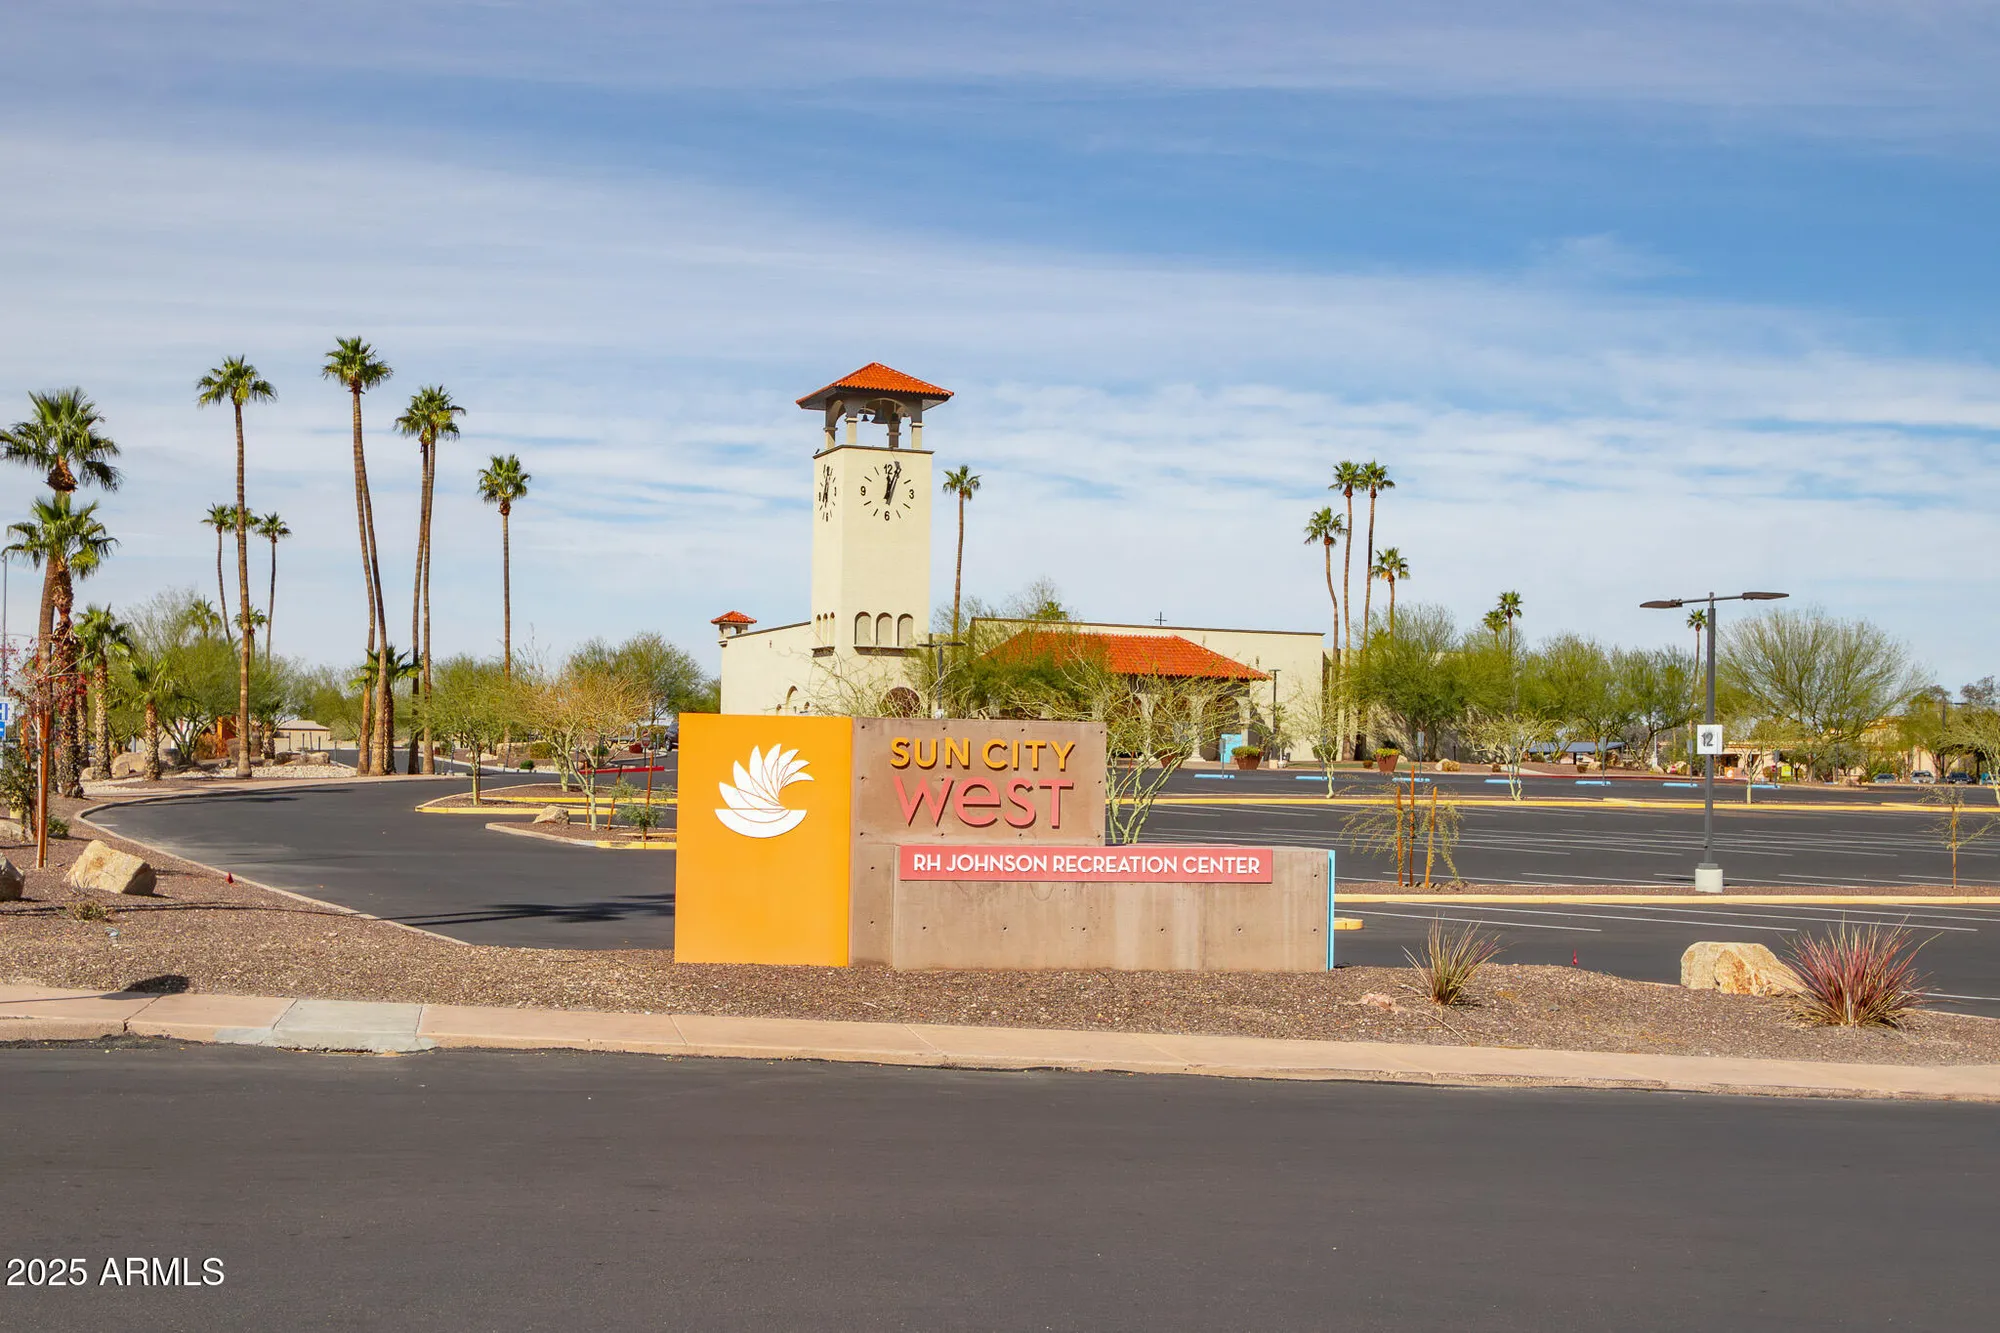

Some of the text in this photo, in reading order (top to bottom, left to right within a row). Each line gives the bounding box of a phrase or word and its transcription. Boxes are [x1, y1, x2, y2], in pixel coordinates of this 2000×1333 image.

[884, 464, 893, 475] 12
[860, 486, 866, 496] 9
[909, 489, 915, 499] 3
[884, 511, 890, 521] 6
[1701, 732, 1714, 747] 12
[890, 737, 1075, 772] SUN CITY
[913, 854, 1260, 874] RH JOHNSON RECREATION CENTER
